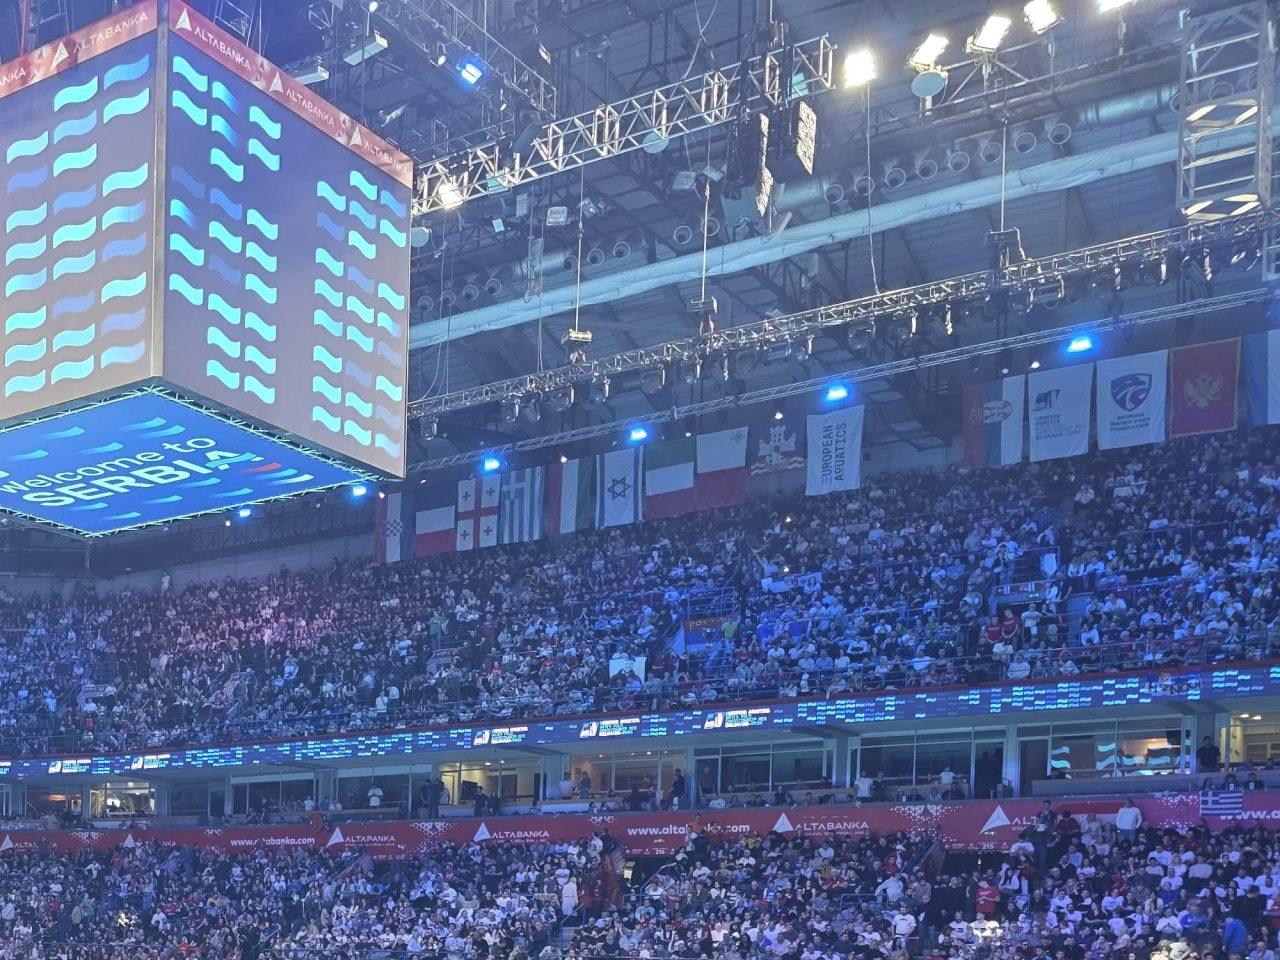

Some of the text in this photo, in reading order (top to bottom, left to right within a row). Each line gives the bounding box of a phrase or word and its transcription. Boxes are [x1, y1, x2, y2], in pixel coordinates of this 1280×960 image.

[73, 12, 149, 54] ALTABANKA
[194, 27, 252, 71] ALTABANKA
[286, 88, 335, 128] ALTABANKA
[362, 142, 408, 175] ALTABANKA
[162, 437, 216, 453] to
[821, 424, 834, 484] EUROPEAN
[22, 450, 264, 507] SERBIA
[491, 830, 550, 839] ALTABANKA
[795, 821, 869, 832] ALTABANKA
